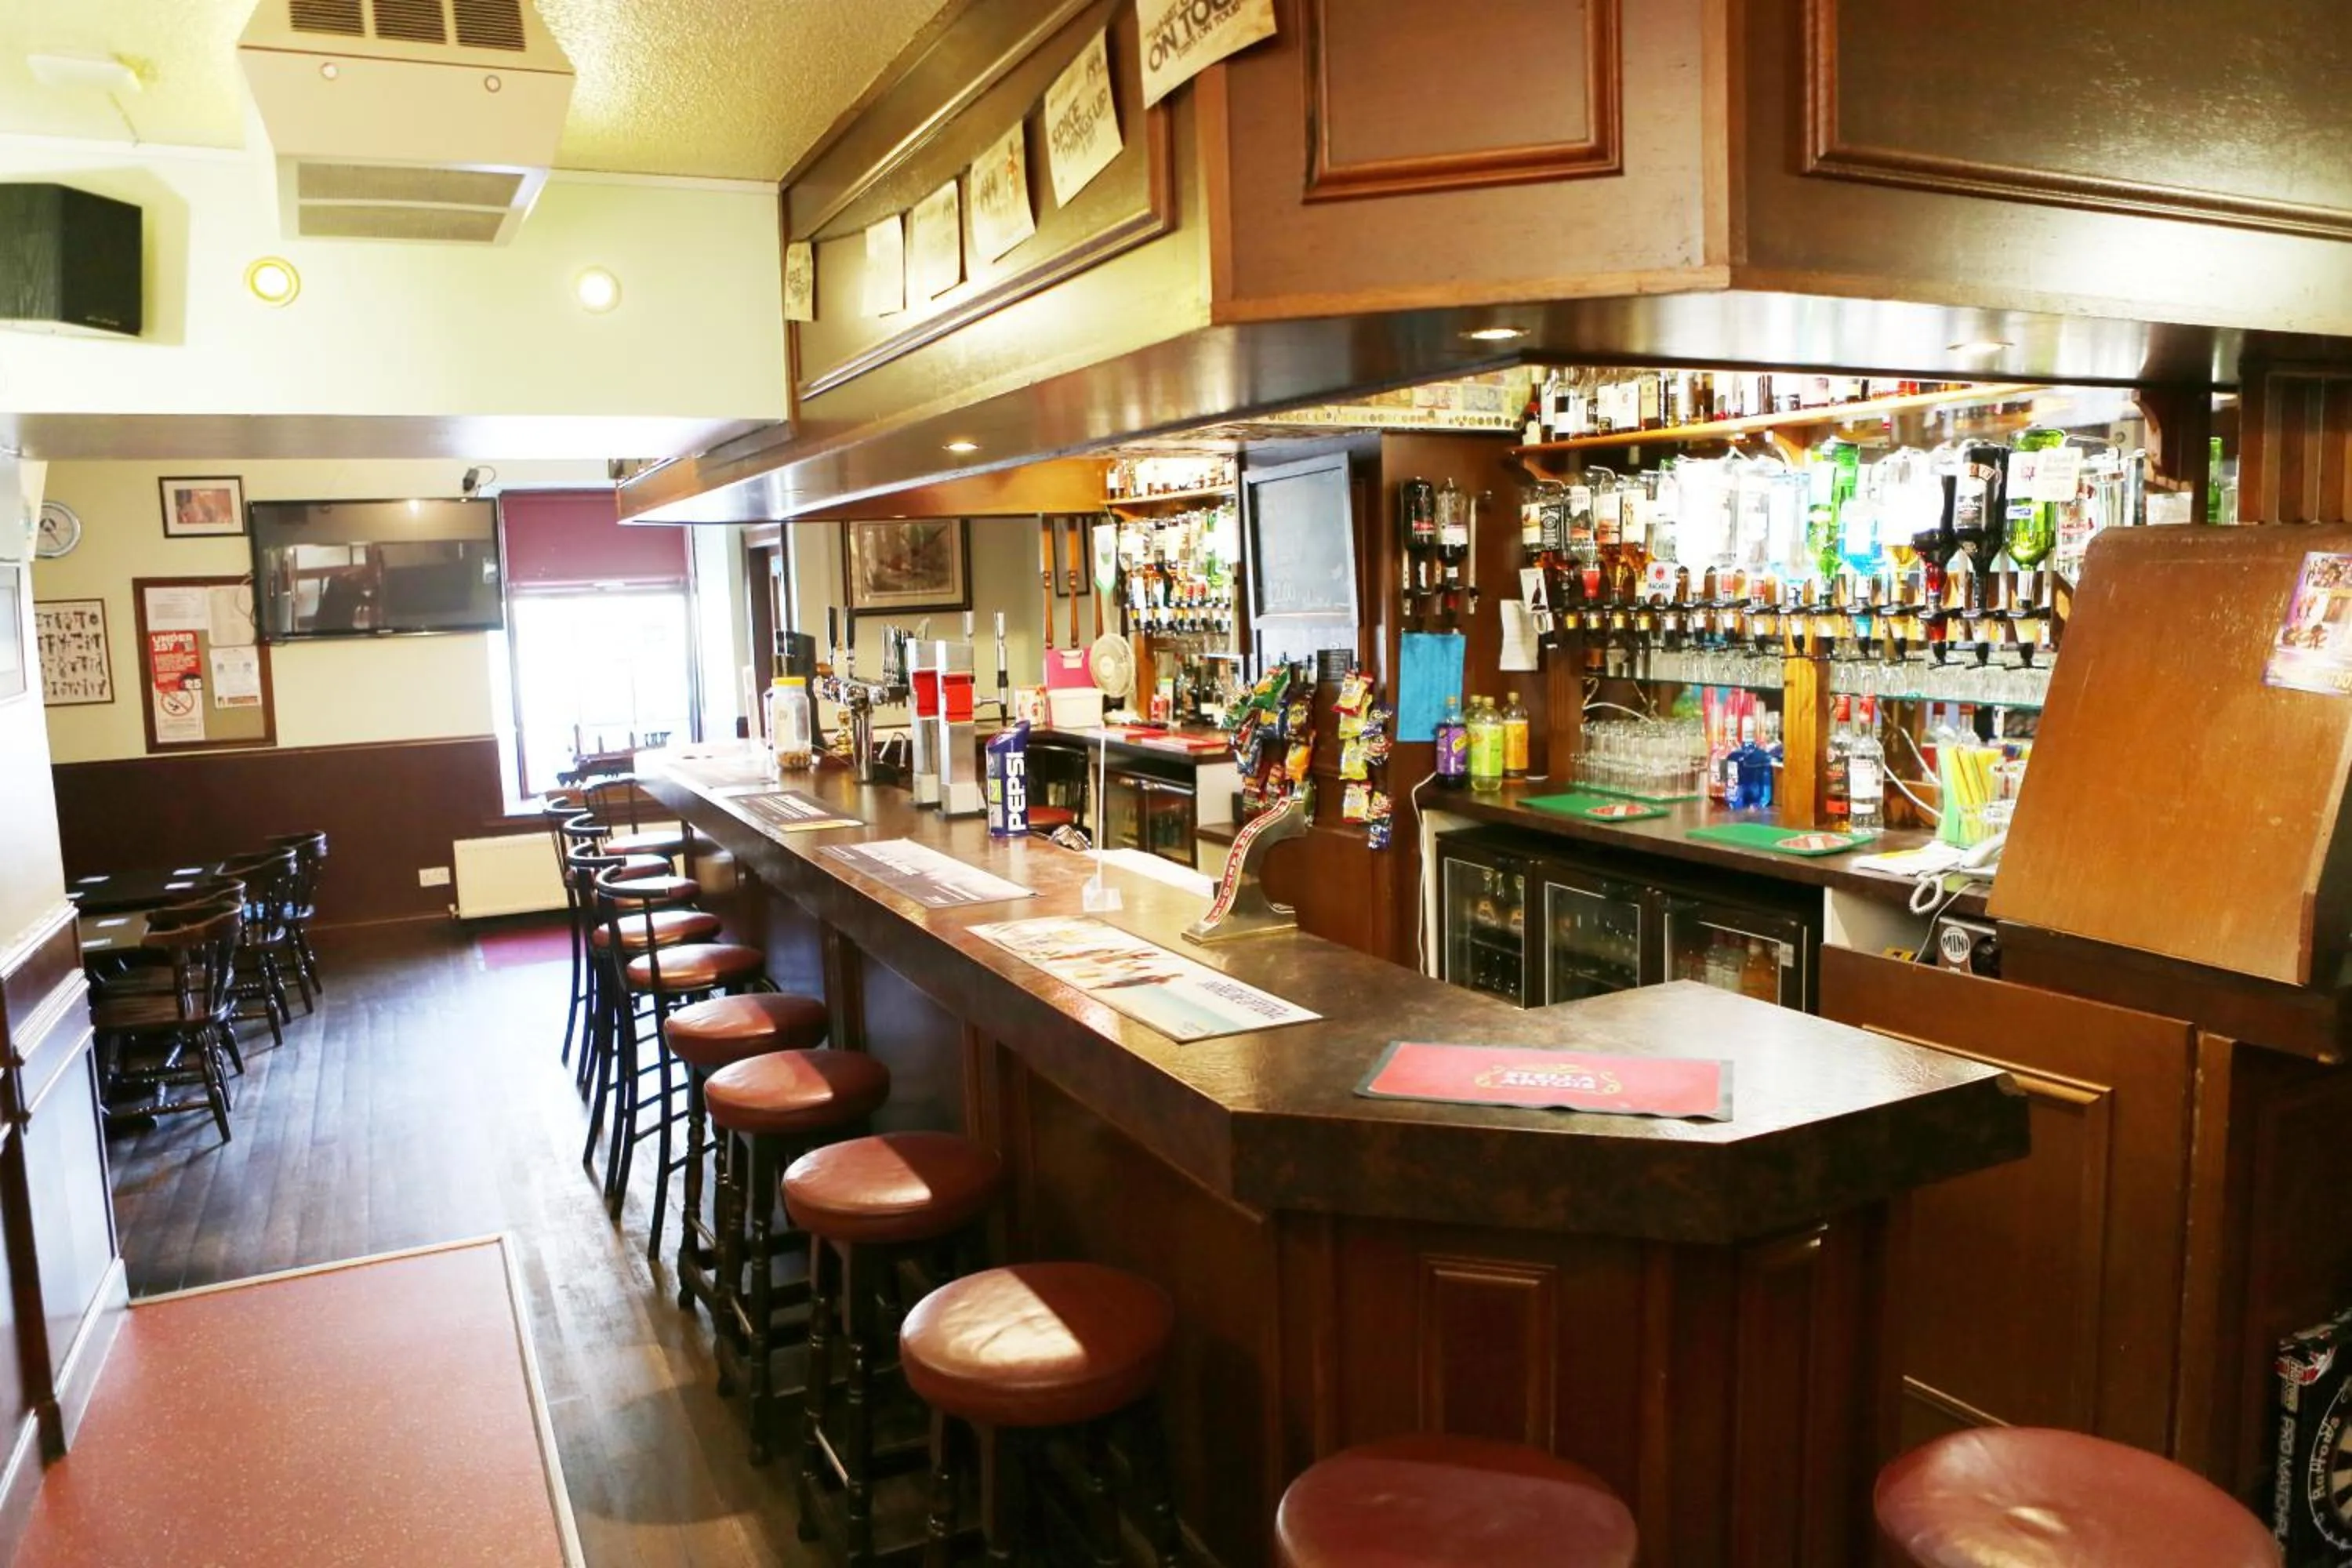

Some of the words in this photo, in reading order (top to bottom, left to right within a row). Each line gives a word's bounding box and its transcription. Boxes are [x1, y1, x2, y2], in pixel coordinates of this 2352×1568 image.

[1149, 23, 1178, 72] ON
[1005, 752, 1026, 832] PEPSI
[1942, 934, 1969, 953] MINI
[2279, 1415, 2296, 1456] PRO
